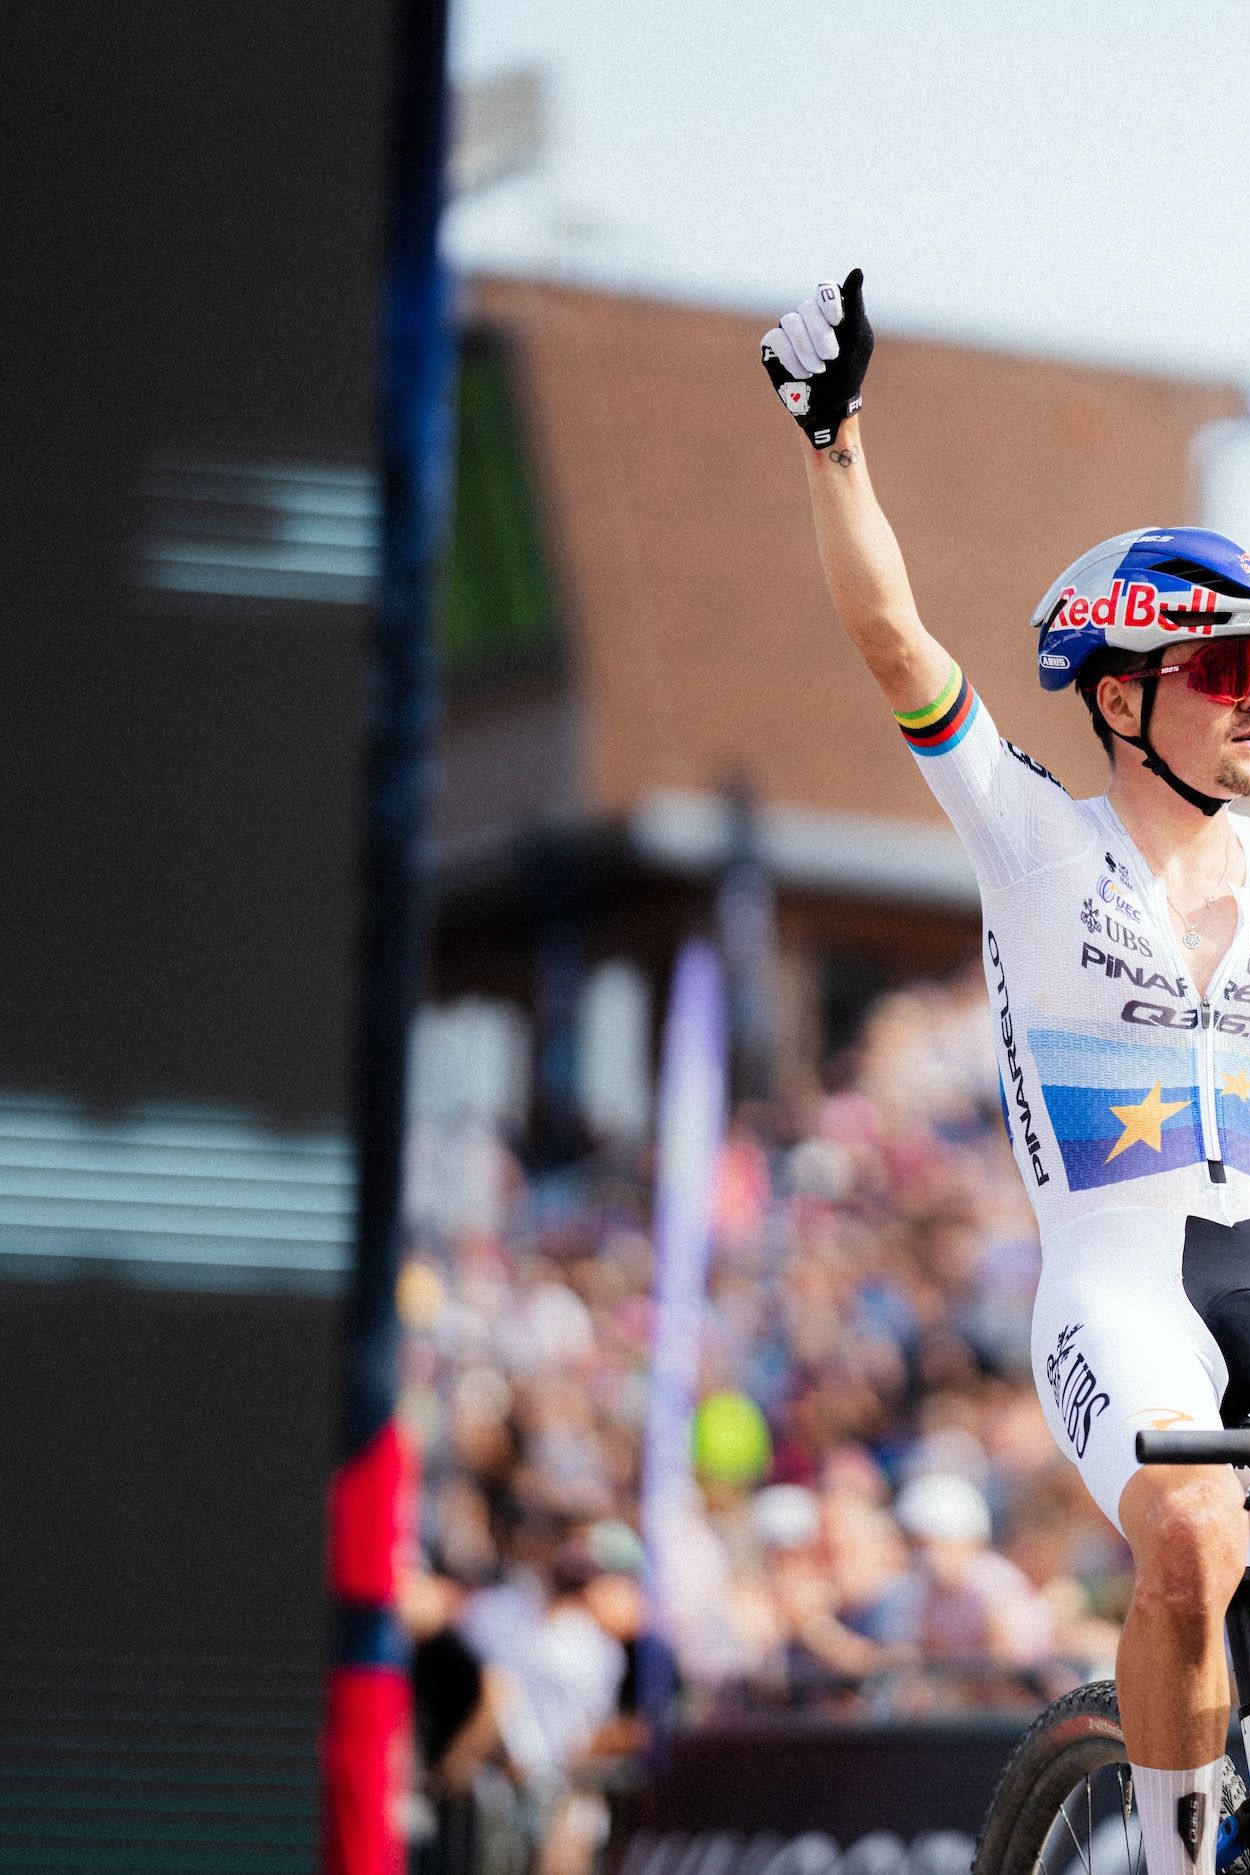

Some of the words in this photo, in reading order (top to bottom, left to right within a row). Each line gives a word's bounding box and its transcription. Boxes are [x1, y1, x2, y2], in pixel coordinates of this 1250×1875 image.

[1052, 580, 1123, 629] Red
[1041, 656, 1066, 668] ABUS
[1116, 896, 1141, 921] UEC
[1104, 914, 1153, 958] UBS
[1061, 1352, 1111, 1460] UBS
